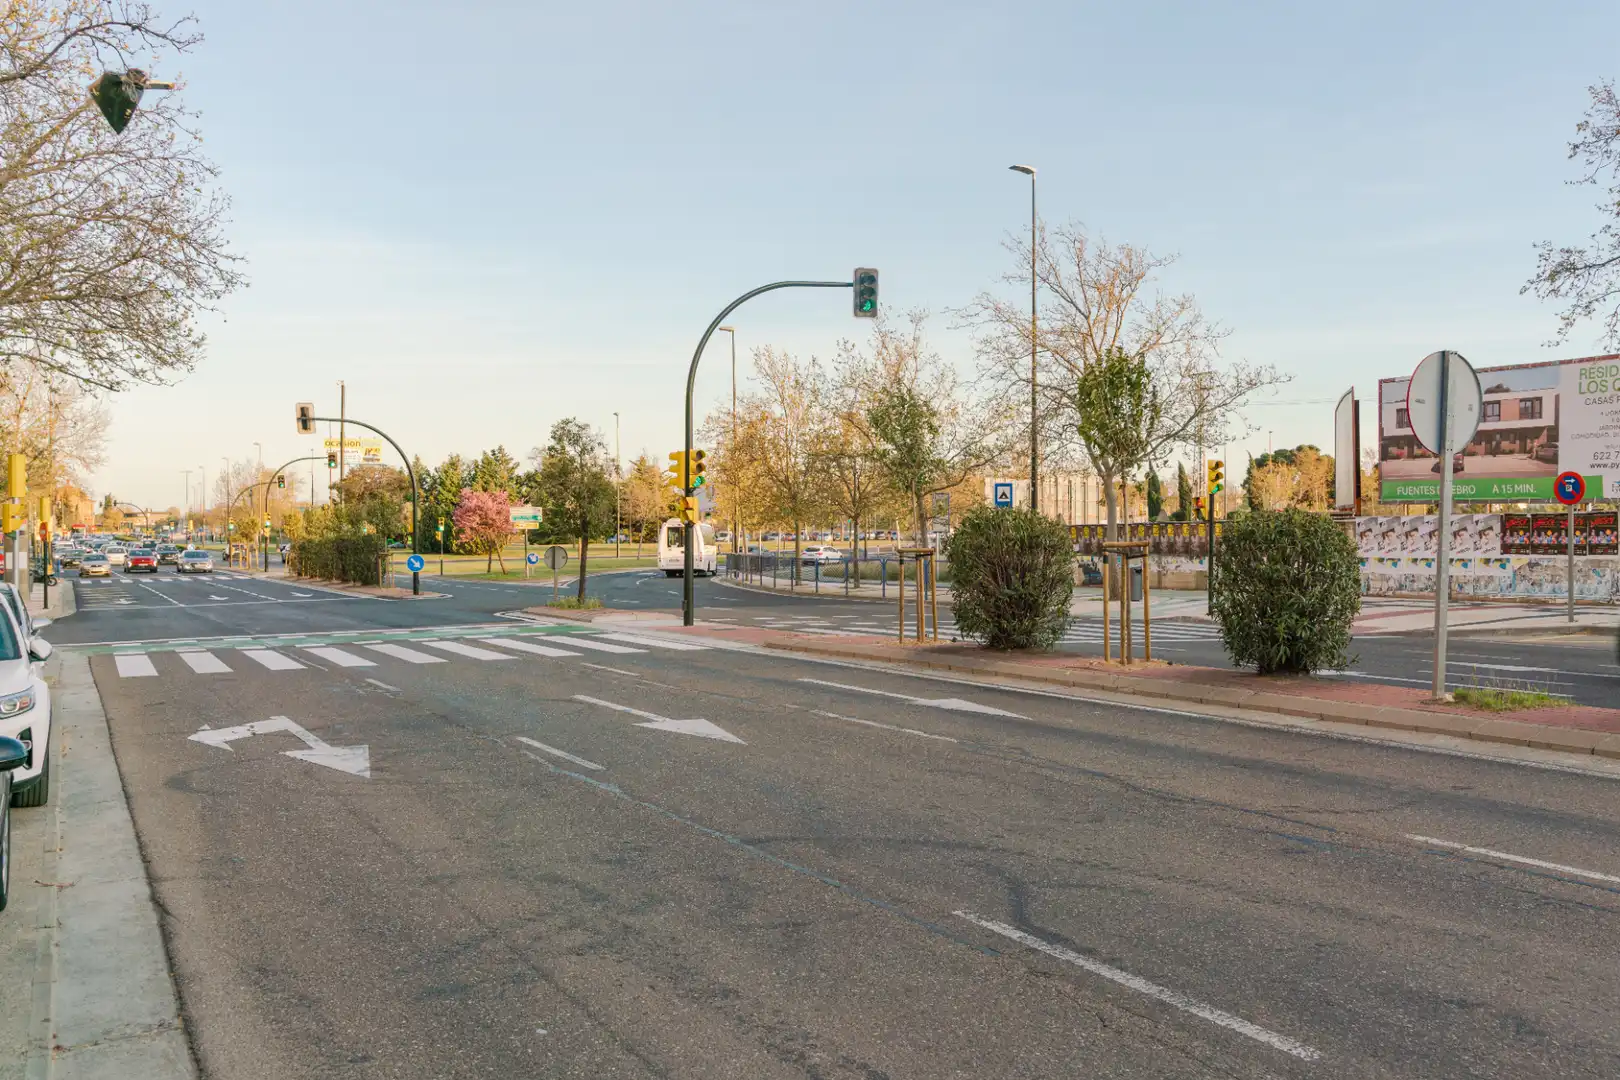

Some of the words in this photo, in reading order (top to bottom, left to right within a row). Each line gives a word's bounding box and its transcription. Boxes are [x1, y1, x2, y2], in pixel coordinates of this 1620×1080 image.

[1579, 365, 1620, 380] RESID
[1578, 380, 1609, 395] LOS
[1593, 451, 1611, 460] 622
[1396, 486, 1436, 496] FUENTES
[1492, 485, 1500, 494] A
[1501, 485, 1513, 494] 15
[1514, 484, 1537, 493] MIN.
